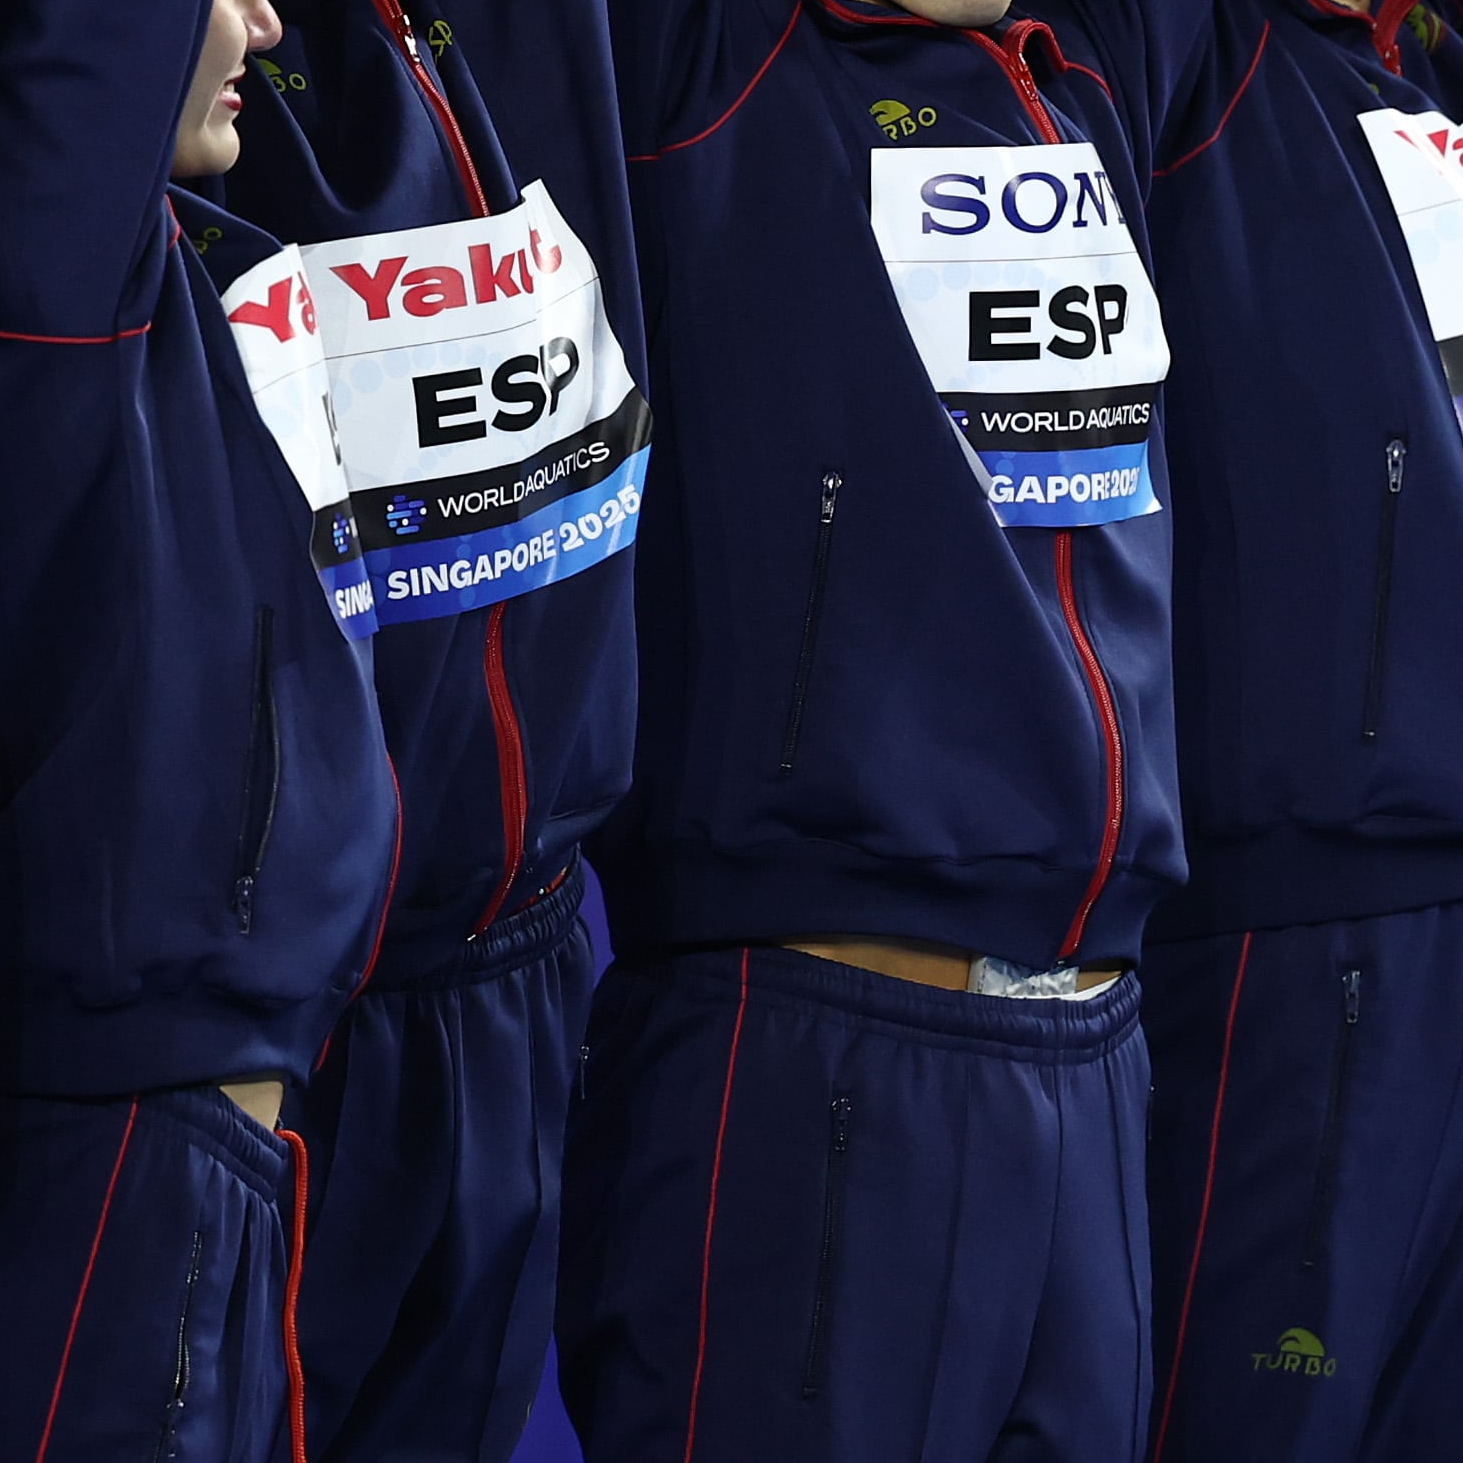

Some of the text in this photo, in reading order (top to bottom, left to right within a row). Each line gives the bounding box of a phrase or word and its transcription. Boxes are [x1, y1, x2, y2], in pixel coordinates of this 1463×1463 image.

[921, 170, 1127, 235] SON
[968, 283, 1129, 362] ESP
[412, 337, 580, 449] ESP
[988, 472, 1110, 504] GAPORE
[387, 483, 641, 600] SINGAPORE 2025
[1251, 1352, 1337, 1377] TURBO
